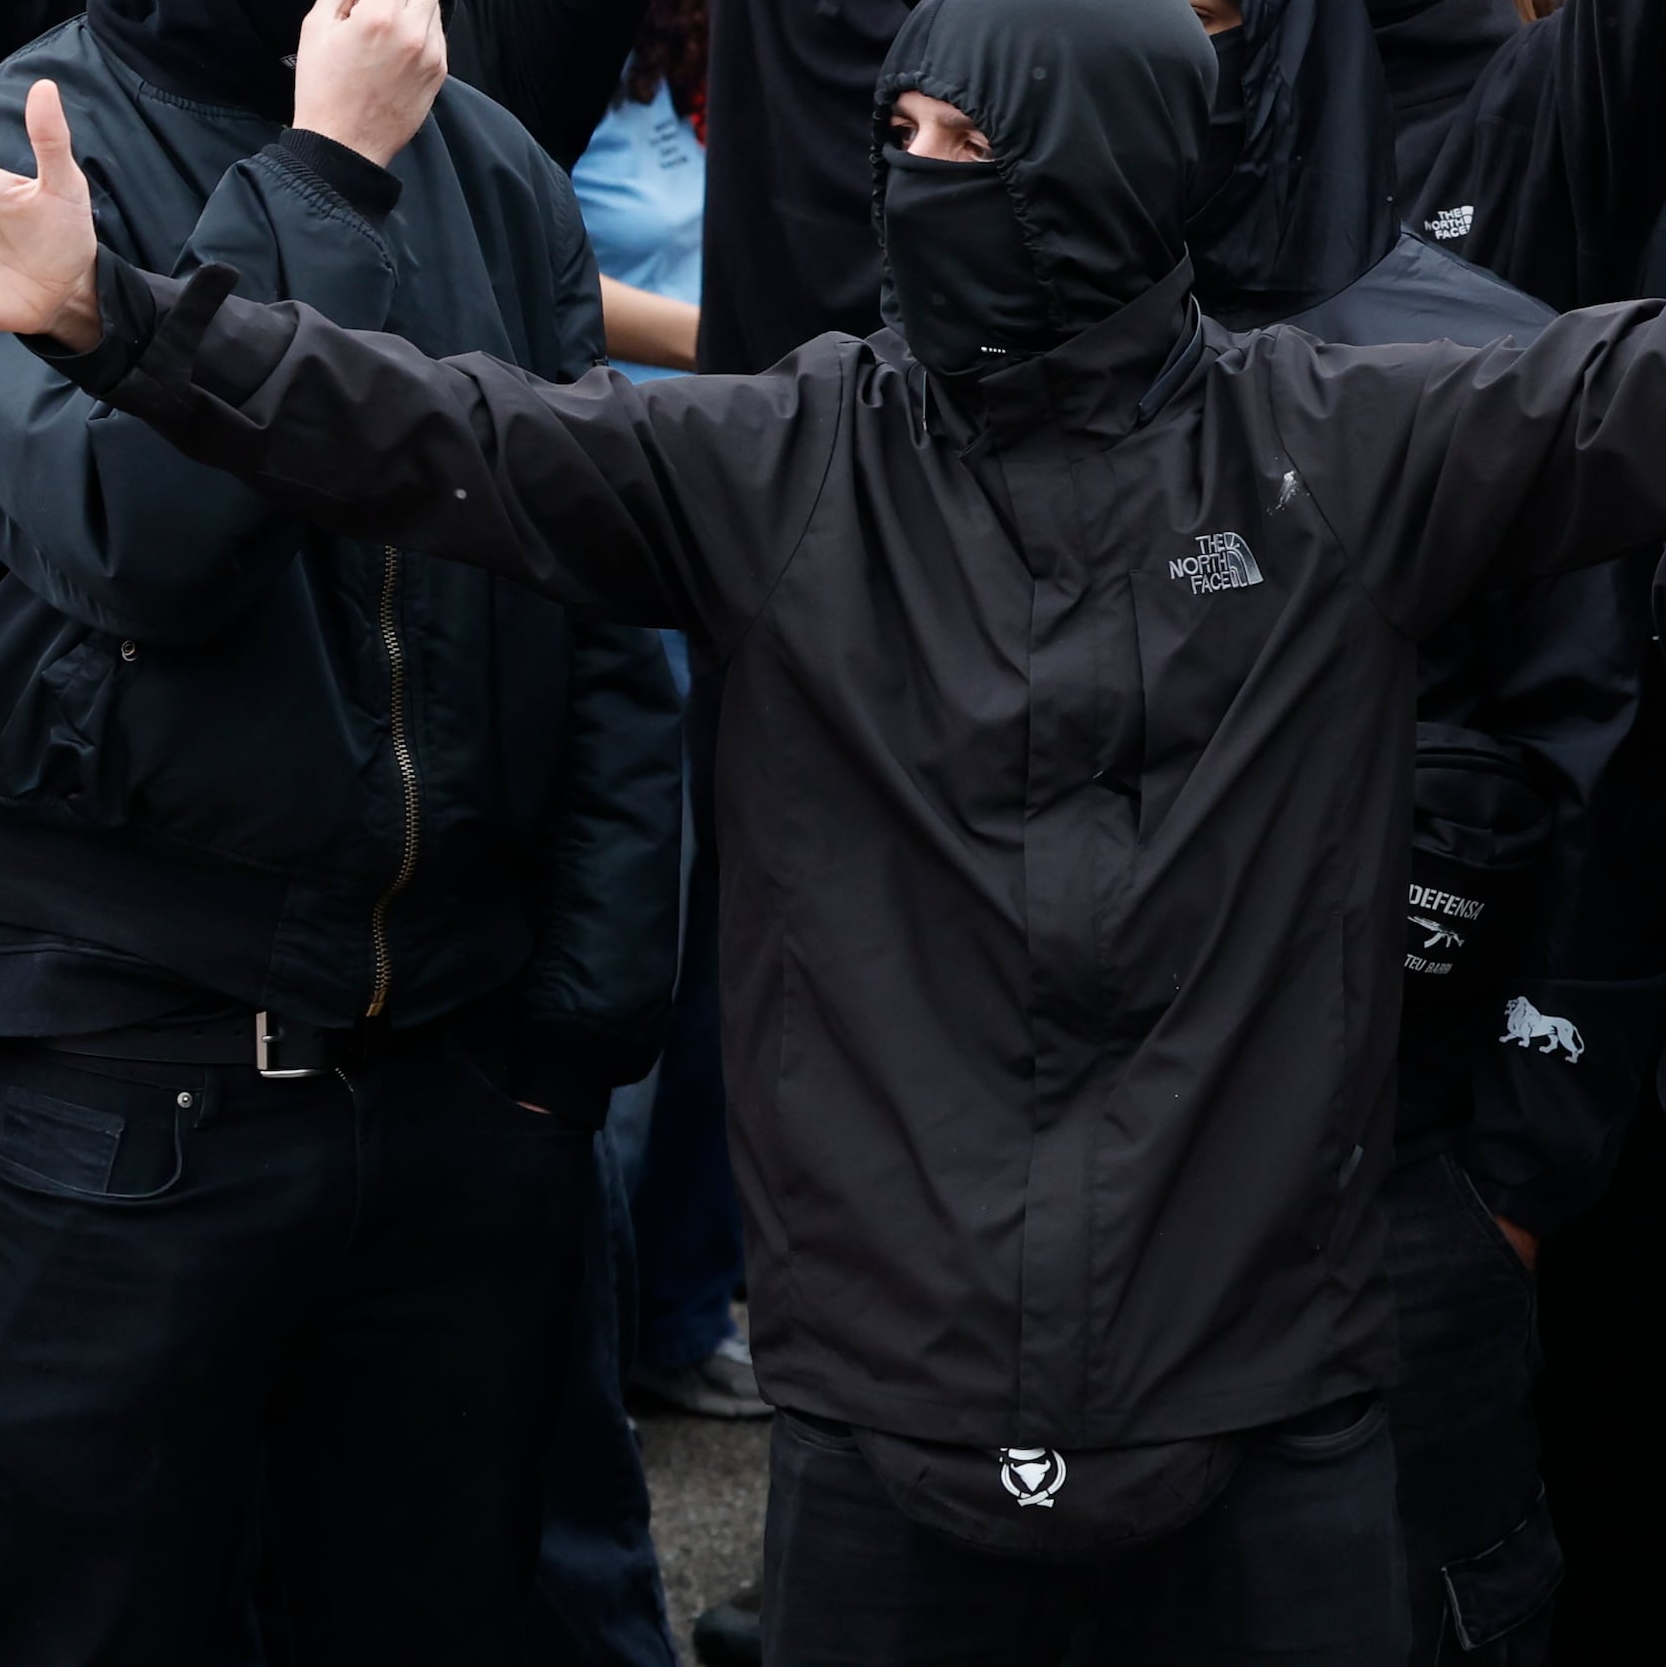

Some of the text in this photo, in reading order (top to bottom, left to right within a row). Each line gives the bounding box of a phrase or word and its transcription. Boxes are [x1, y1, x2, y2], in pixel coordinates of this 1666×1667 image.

[1437, 207, 1462, 220] THE
[1435, 225, 1468, 240] FACE
[1194, 533, 1225, 555] THE
[1168, 551, 1229, 580] NORTH
[1190, 570, 1232, 595] FACE
[1408, 883, 1485, 921] DEFENSA
[1403, 953, 1427, 971] TEU
